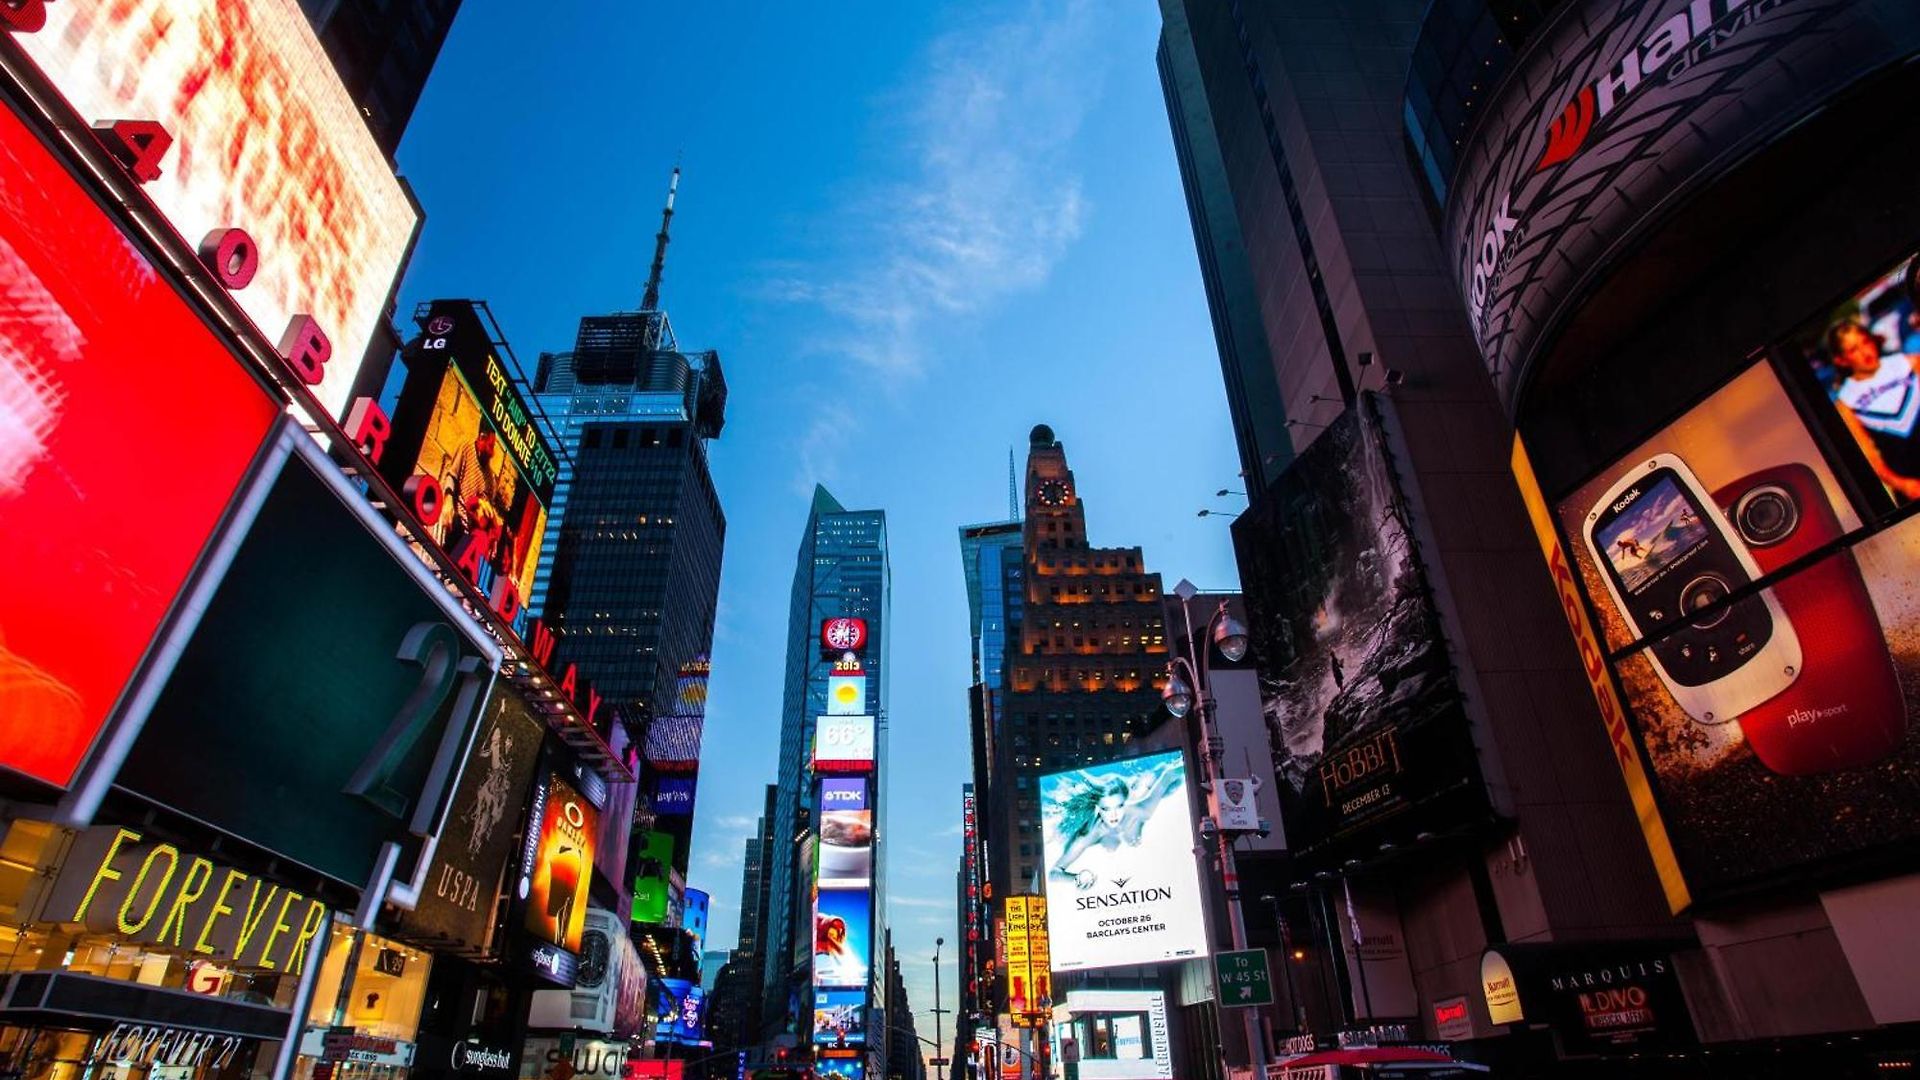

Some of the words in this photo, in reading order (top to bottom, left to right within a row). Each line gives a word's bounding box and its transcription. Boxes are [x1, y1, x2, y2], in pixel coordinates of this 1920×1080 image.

[423, 338, 447, 349] LG
[486, 354, 507, 397] TEXT
[502, 420, 532, 468] DONATE
[1613, 489, 1640, 514] Kodak
[836, 661, 860, 671] 2013
[1551, 543, 1631, 772] Kodak
[1787, 709, 1816, 727] play
[836, 790, 862, 802] TDK
[1342, 789, 1381, 815] DECEMBER
[437, 863, 480, 912] USPA
[1076, 886, 1172, 911] SENSATION
[73, 827, 326, 977] FOREVER
[1086, 926, 1130, 939] BARCLAYS
[1132, 923, 1166, 934] CENTER
[1098, 915, 1138, 928] OCTOBER
[1140, 914, 1151, 922] 26
[1234, 957, 1248, 967] To
[1221, 972, 1231, 983] W
[1236, 971, 1250, 982] 45
[1253, 970, 1266, 981] St
[1552, 960, 1664, 990] MARQUIS
[1595, 986, 1646, 1011] DIVO
[98, 1023, 214, 1066] FOREVER
[211, 1036, 243, 1070] 21
